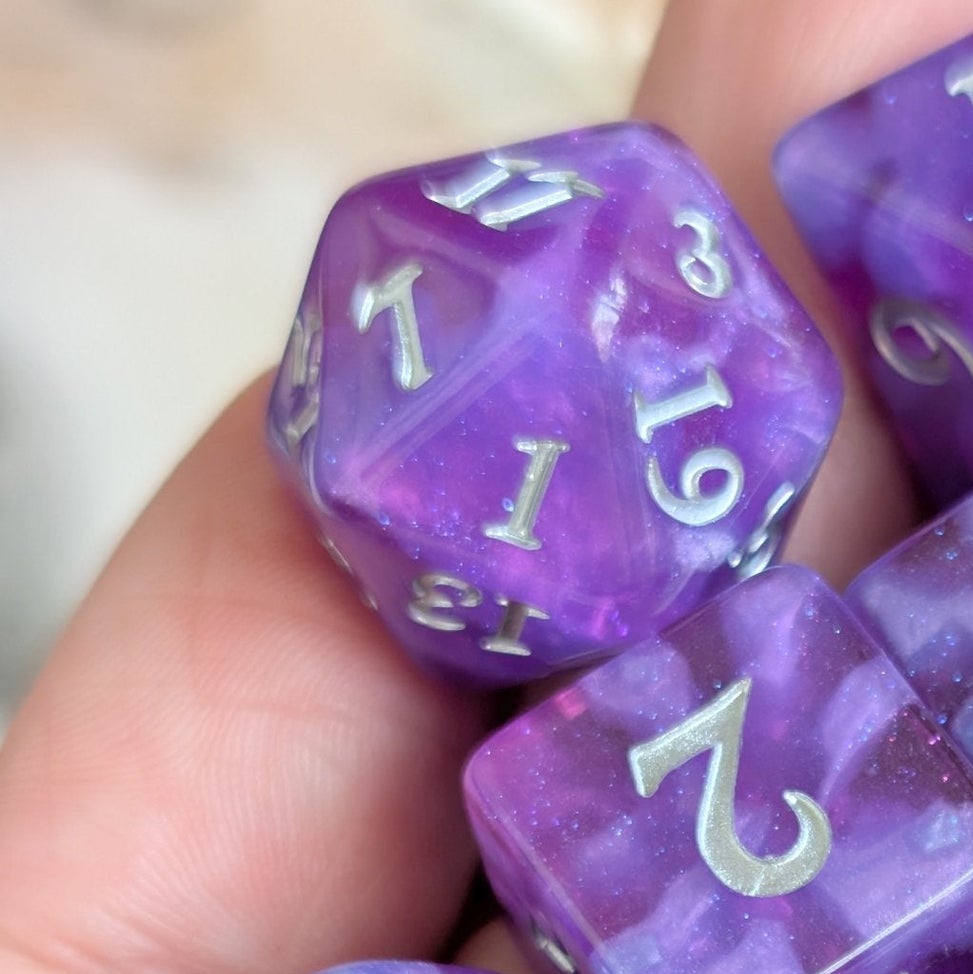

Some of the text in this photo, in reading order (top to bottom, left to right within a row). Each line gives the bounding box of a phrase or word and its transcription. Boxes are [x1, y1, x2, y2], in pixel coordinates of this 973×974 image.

[674, 210, 733, 298] 3
[354, 264, 433, 390] 7
[482, 440, 570, 550] 1
[632, 364, 744, 526] 19
[407, 573, 550, 657] 13
[628, 677, 831, 897] 2
